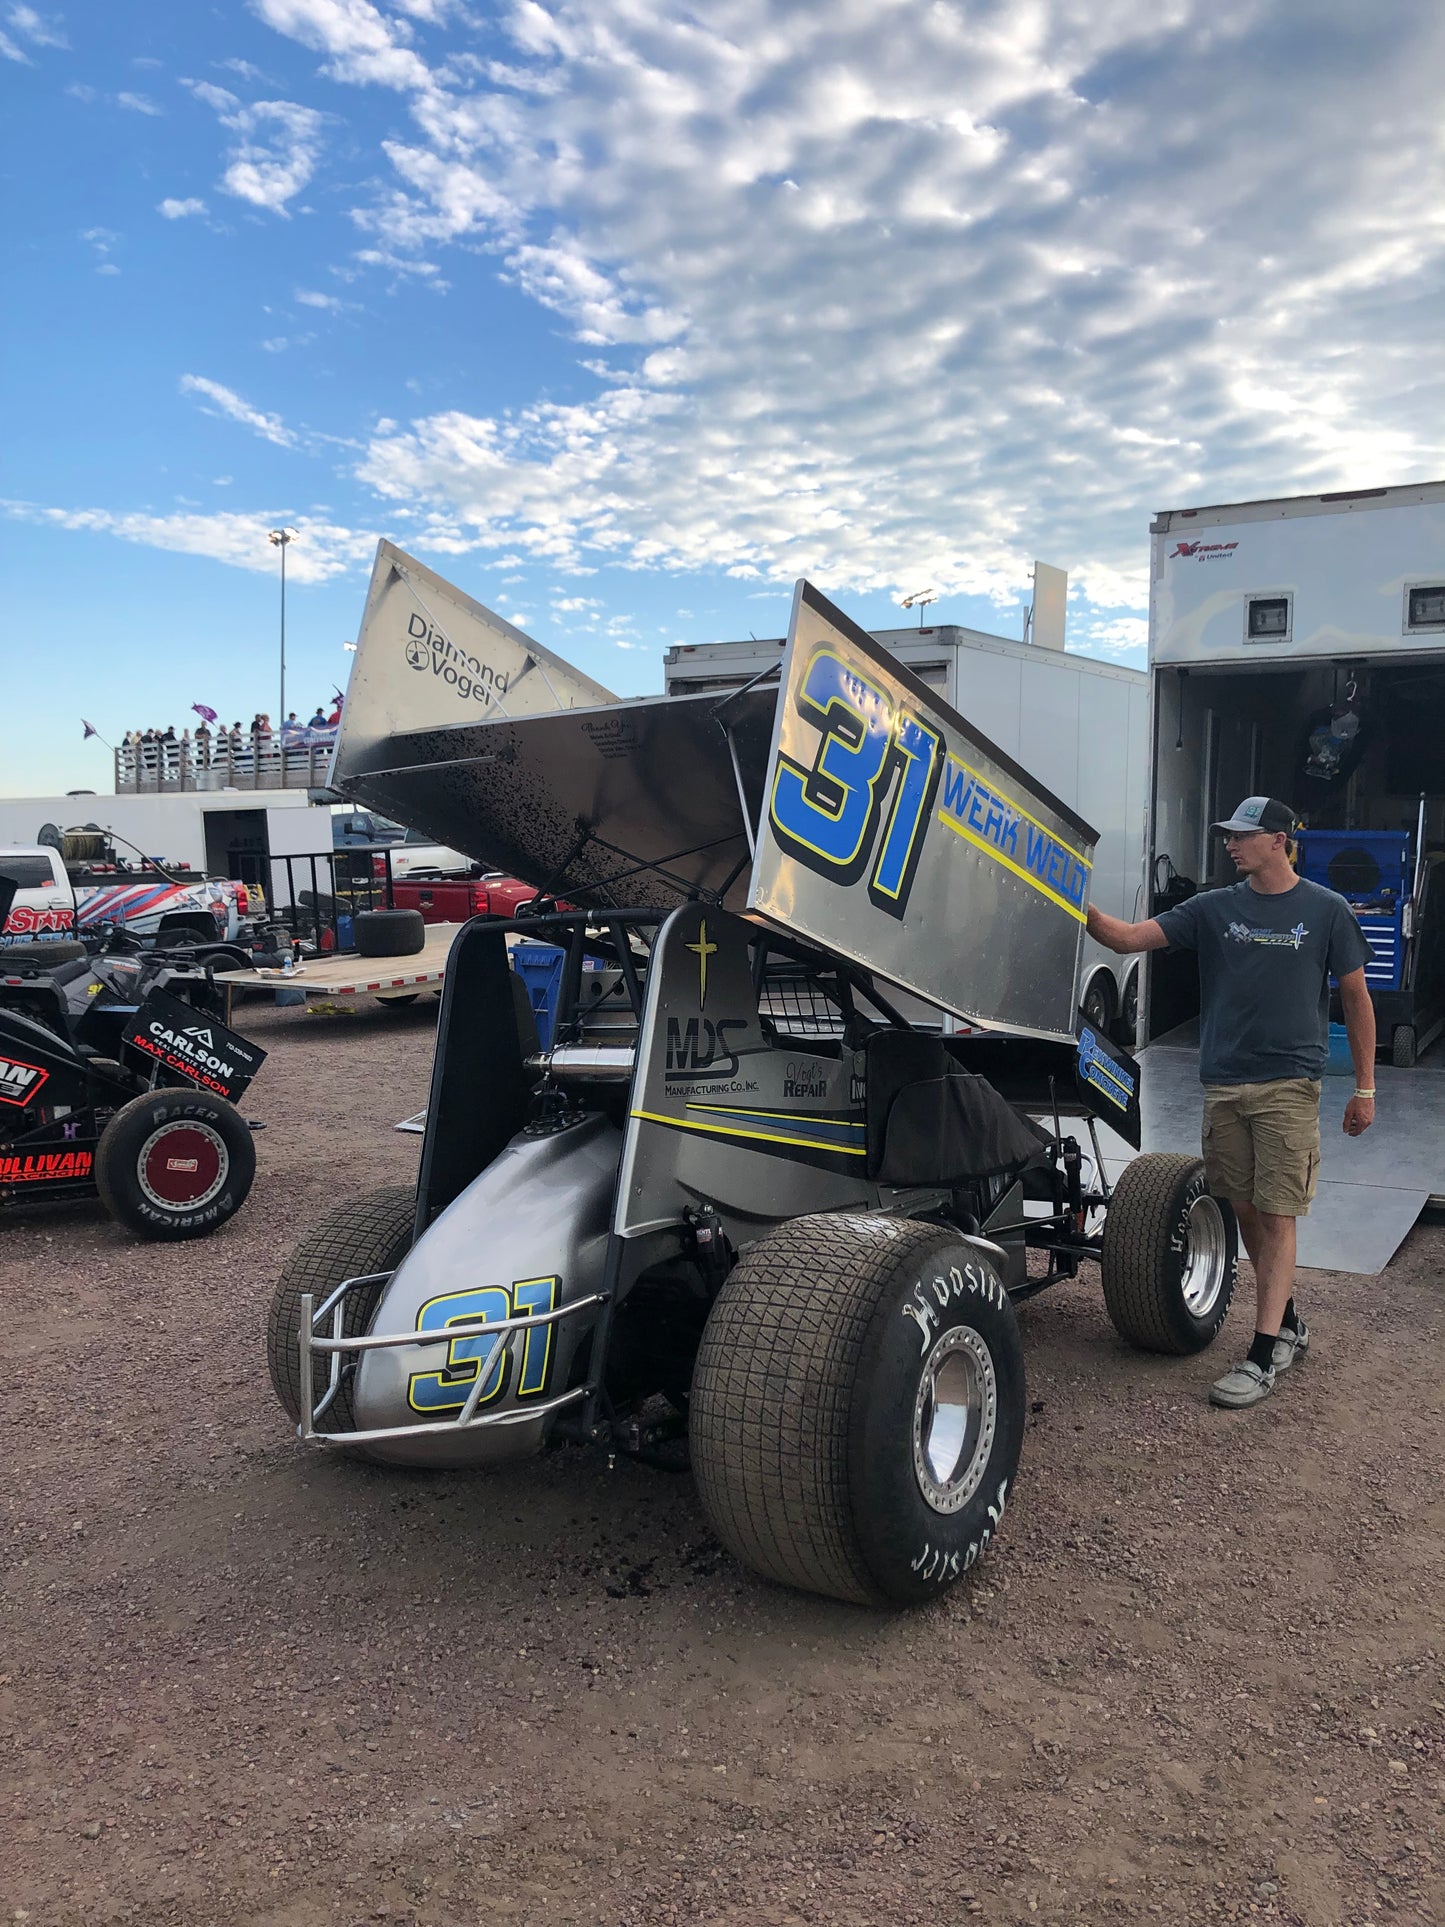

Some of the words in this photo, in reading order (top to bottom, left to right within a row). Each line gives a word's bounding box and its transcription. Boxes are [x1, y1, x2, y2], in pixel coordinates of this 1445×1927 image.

[408, 613, 510, 693] Diamond
[432, 651, 491, 705] Vogel
[770, 645, 942, 910] 31
[943, 761, 1021, 855] WERK
[1025, 823, 1088, 906] WELD
[2, 906, 75, 934] STAR
[133, 1035, 165, 1058] MAX
[166, 1055, 231, 1097] CARLSON
[149, 1021, 234, 1078] CARLSON
[153, 1038, 171, 1052] REAL
[173, 1050, 198, 1067] ESTATE
[199, 1065, 218, 1079] TEAM
[665, 1017, 749, 1082] MDS
[786, 1062, 823, 1085] Vogt's
[664, 1083, 729, 1097] MANUFACTURING
[783, 1079, 827, 1098] REPAIR
[852, 1079, 867, 1100] IN
[1079, 1051, 1129, 1107] CONCRETE
[152, 1105, 219, 1125] RACER
[137, 1192, 234, 1228] AMERICAN
[409, 1276, 561, 1414] 31
